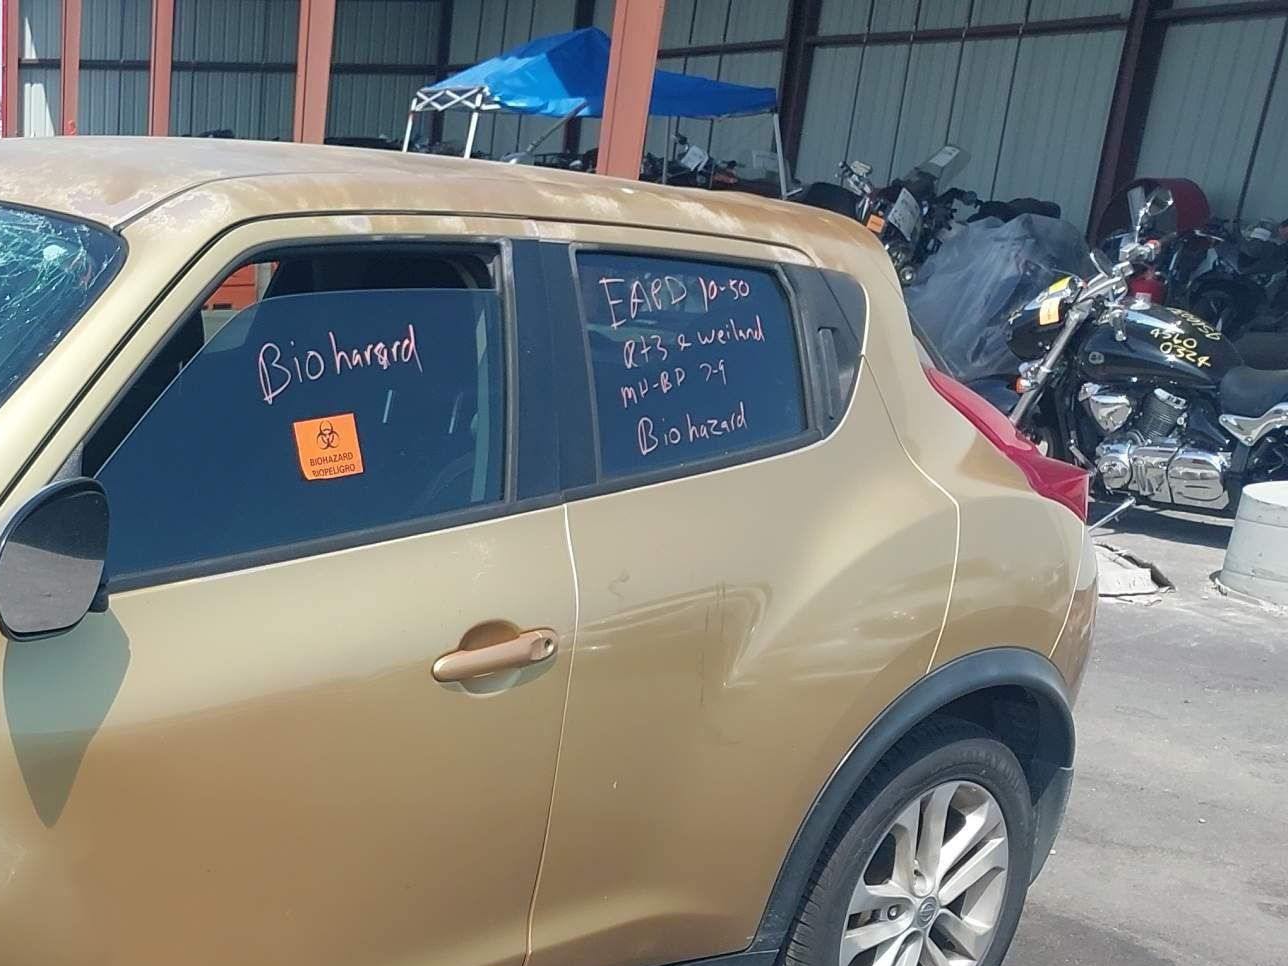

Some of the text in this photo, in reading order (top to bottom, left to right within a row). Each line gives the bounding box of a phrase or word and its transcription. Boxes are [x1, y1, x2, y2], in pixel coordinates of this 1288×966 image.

[698, 276, 750, 312] 10-50
[1159, 342, 1212, 368] 0324
[309, 451, 354, 467] BIOHAZARD
[311, 463, 356, 477] BIOPELIGRO
